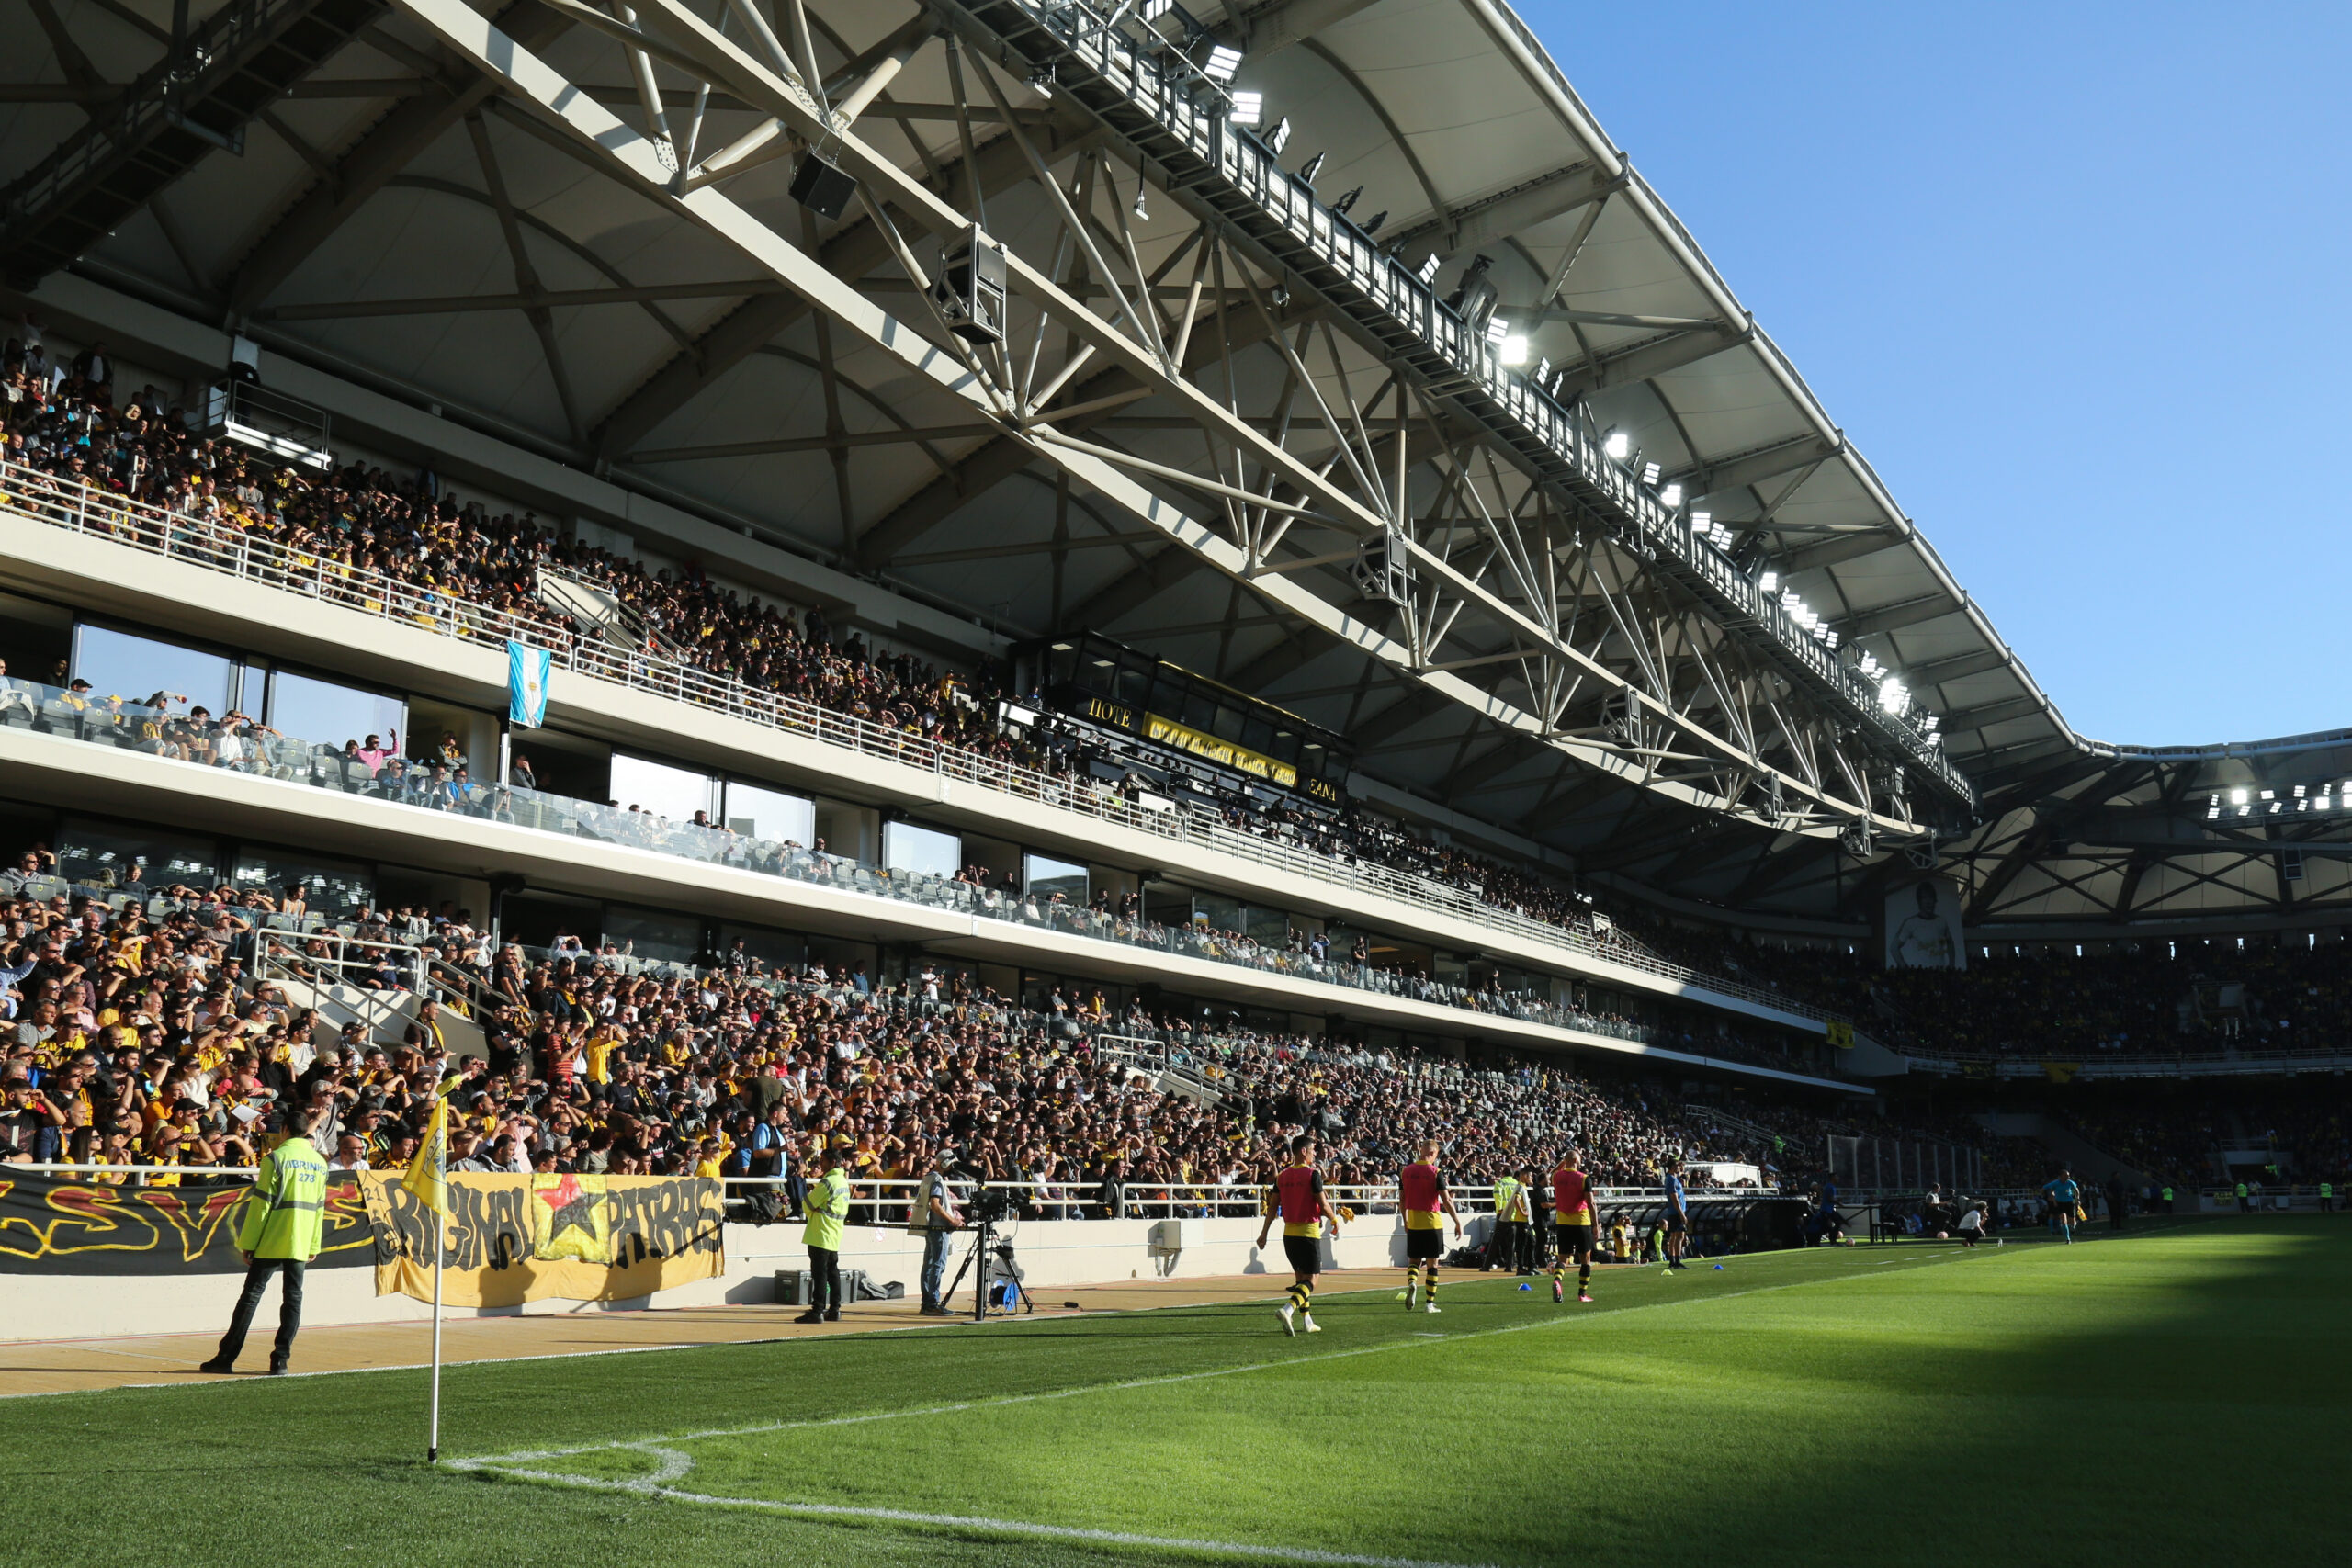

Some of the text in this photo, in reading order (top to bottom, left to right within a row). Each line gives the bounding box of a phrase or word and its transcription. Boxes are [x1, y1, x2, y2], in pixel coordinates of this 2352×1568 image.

[1089, 698, 1132, 728] ΠΟΤΕ
[299, 1172, 316, 1184] 278
[607, 1177, 722, 1269] PATRAS
